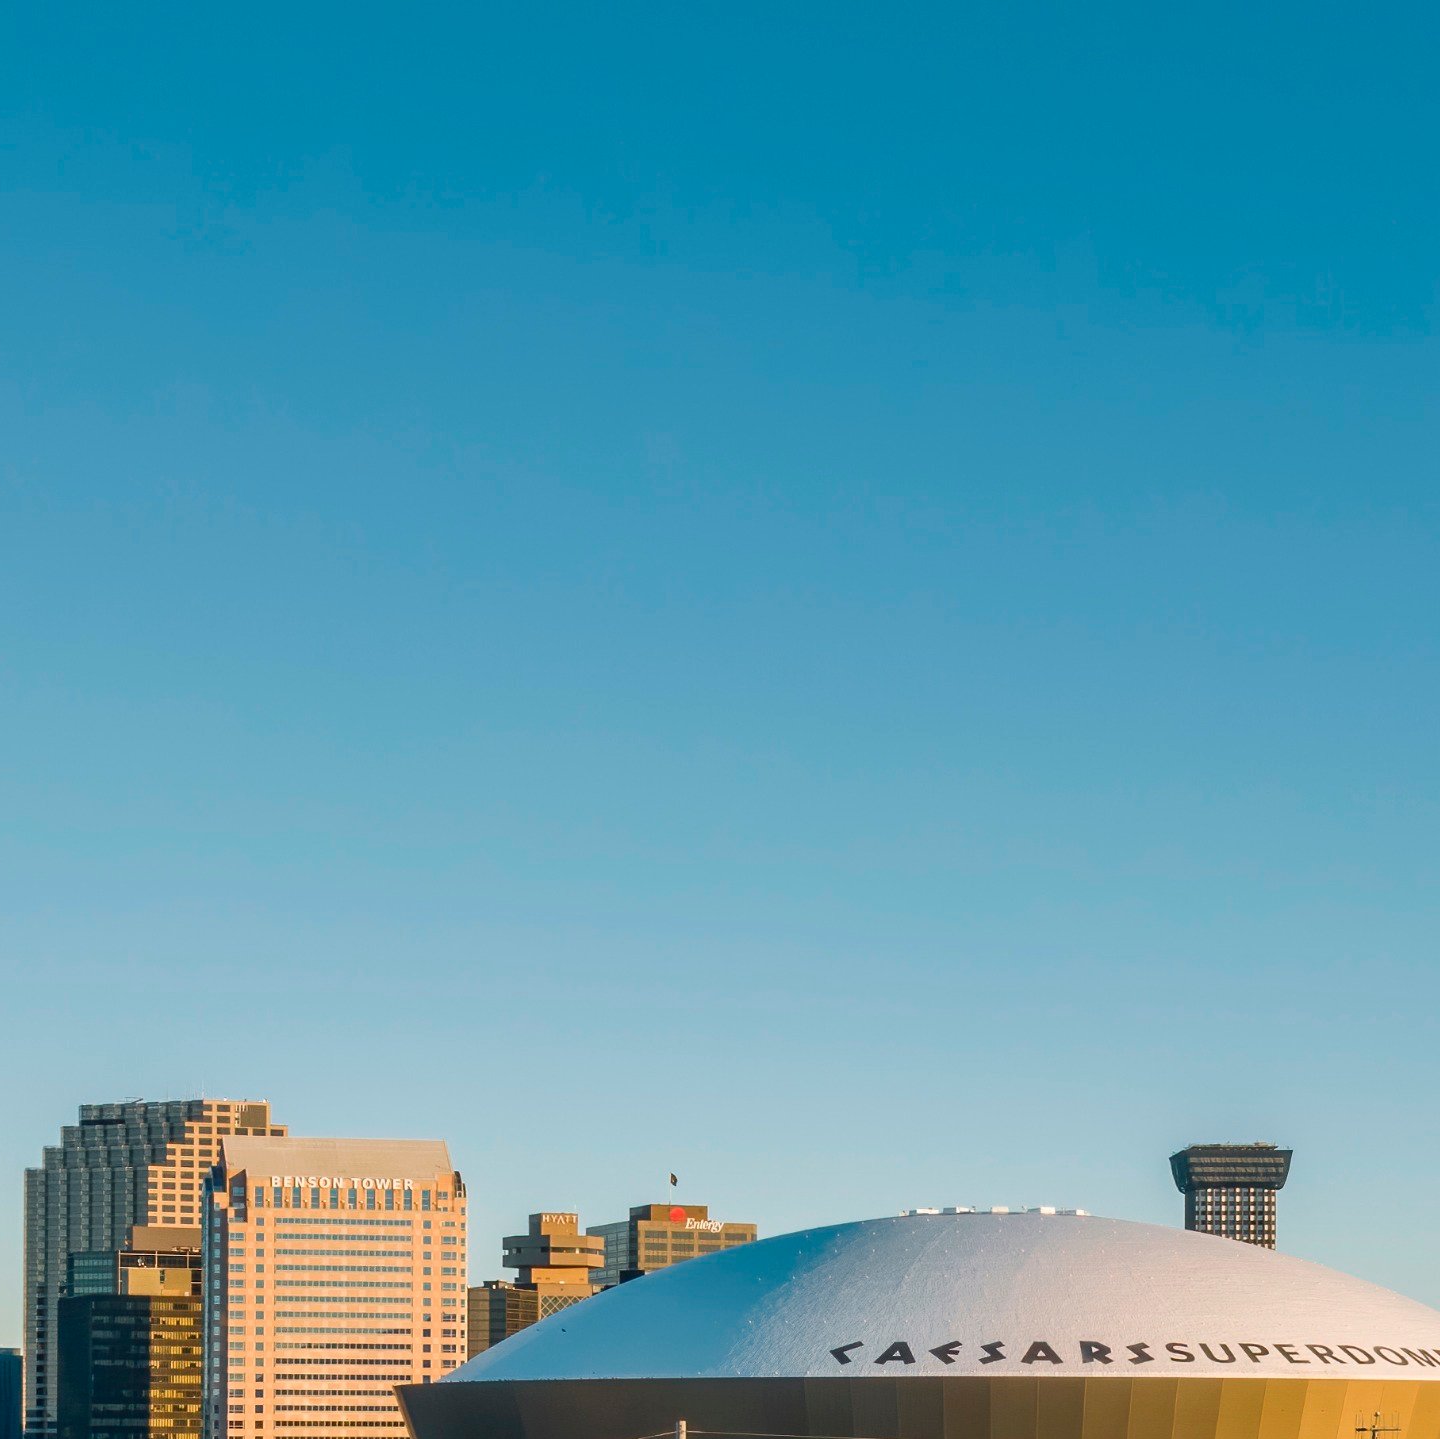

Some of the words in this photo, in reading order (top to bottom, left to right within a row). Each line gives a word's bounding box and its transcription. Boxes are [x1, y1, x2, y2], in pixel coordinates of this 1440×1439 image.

[271, 1176, 343, 1188] BENSON
[351, 1177, 414, 1190] TOWER
[542, 1214, 578, 1224] HYATT
[685, 1218, 724, 1233] Entergy
[830, 1340, 1152, 1366] CAESARS
